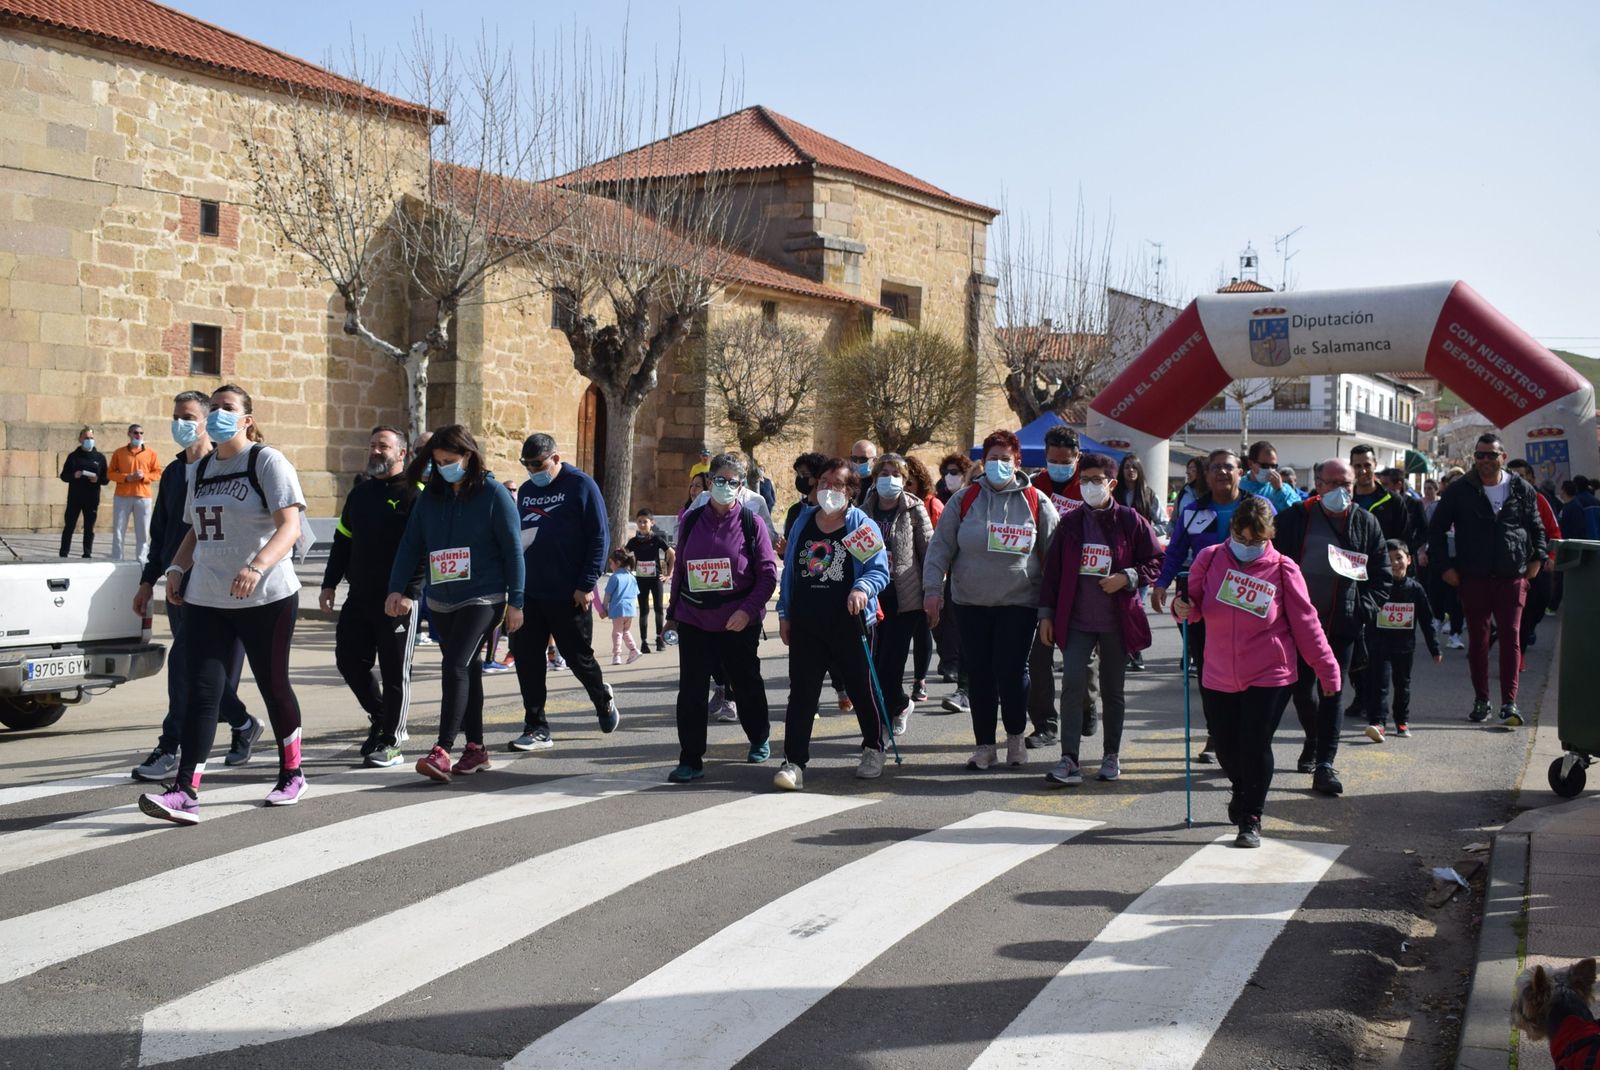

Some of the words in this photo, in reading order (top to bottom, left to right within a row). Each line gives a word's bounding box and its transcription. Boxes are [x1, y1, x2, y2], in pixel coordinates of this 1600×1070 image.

[1292, 310, 1374, 330] Diputación
[1293, 344, 1306, 355] de
[1312, 340, 1391, 354] Salamanca
[1449, 322, 1478, 347] CON
[1477, 343, 1547, 400] NUESTROS
[1110, 393, 1135, 418] CON
[1134, 381, 1152, 396] EL
[1150, 330, 1203, 381] DEPORTE
[1442, 339, 1528, 409] DEPORTISTAS
[522, 492, 566, 506] Reebok
[195, 505, 225, 541] H
[1001, 533, 1019, 546] 77
[440, 560, 457, 574] 82
[688, 560, 730, 571] bedunia
[1081, 555, 1098, 567] 80
[701, 570, 719, 583] 72
[1236, 585, 1257, 603] 90
[1388, 612, 1403, 622] 63
[35, 662, 64, 678] 9705
[68, 659, 90, 674] GYM
